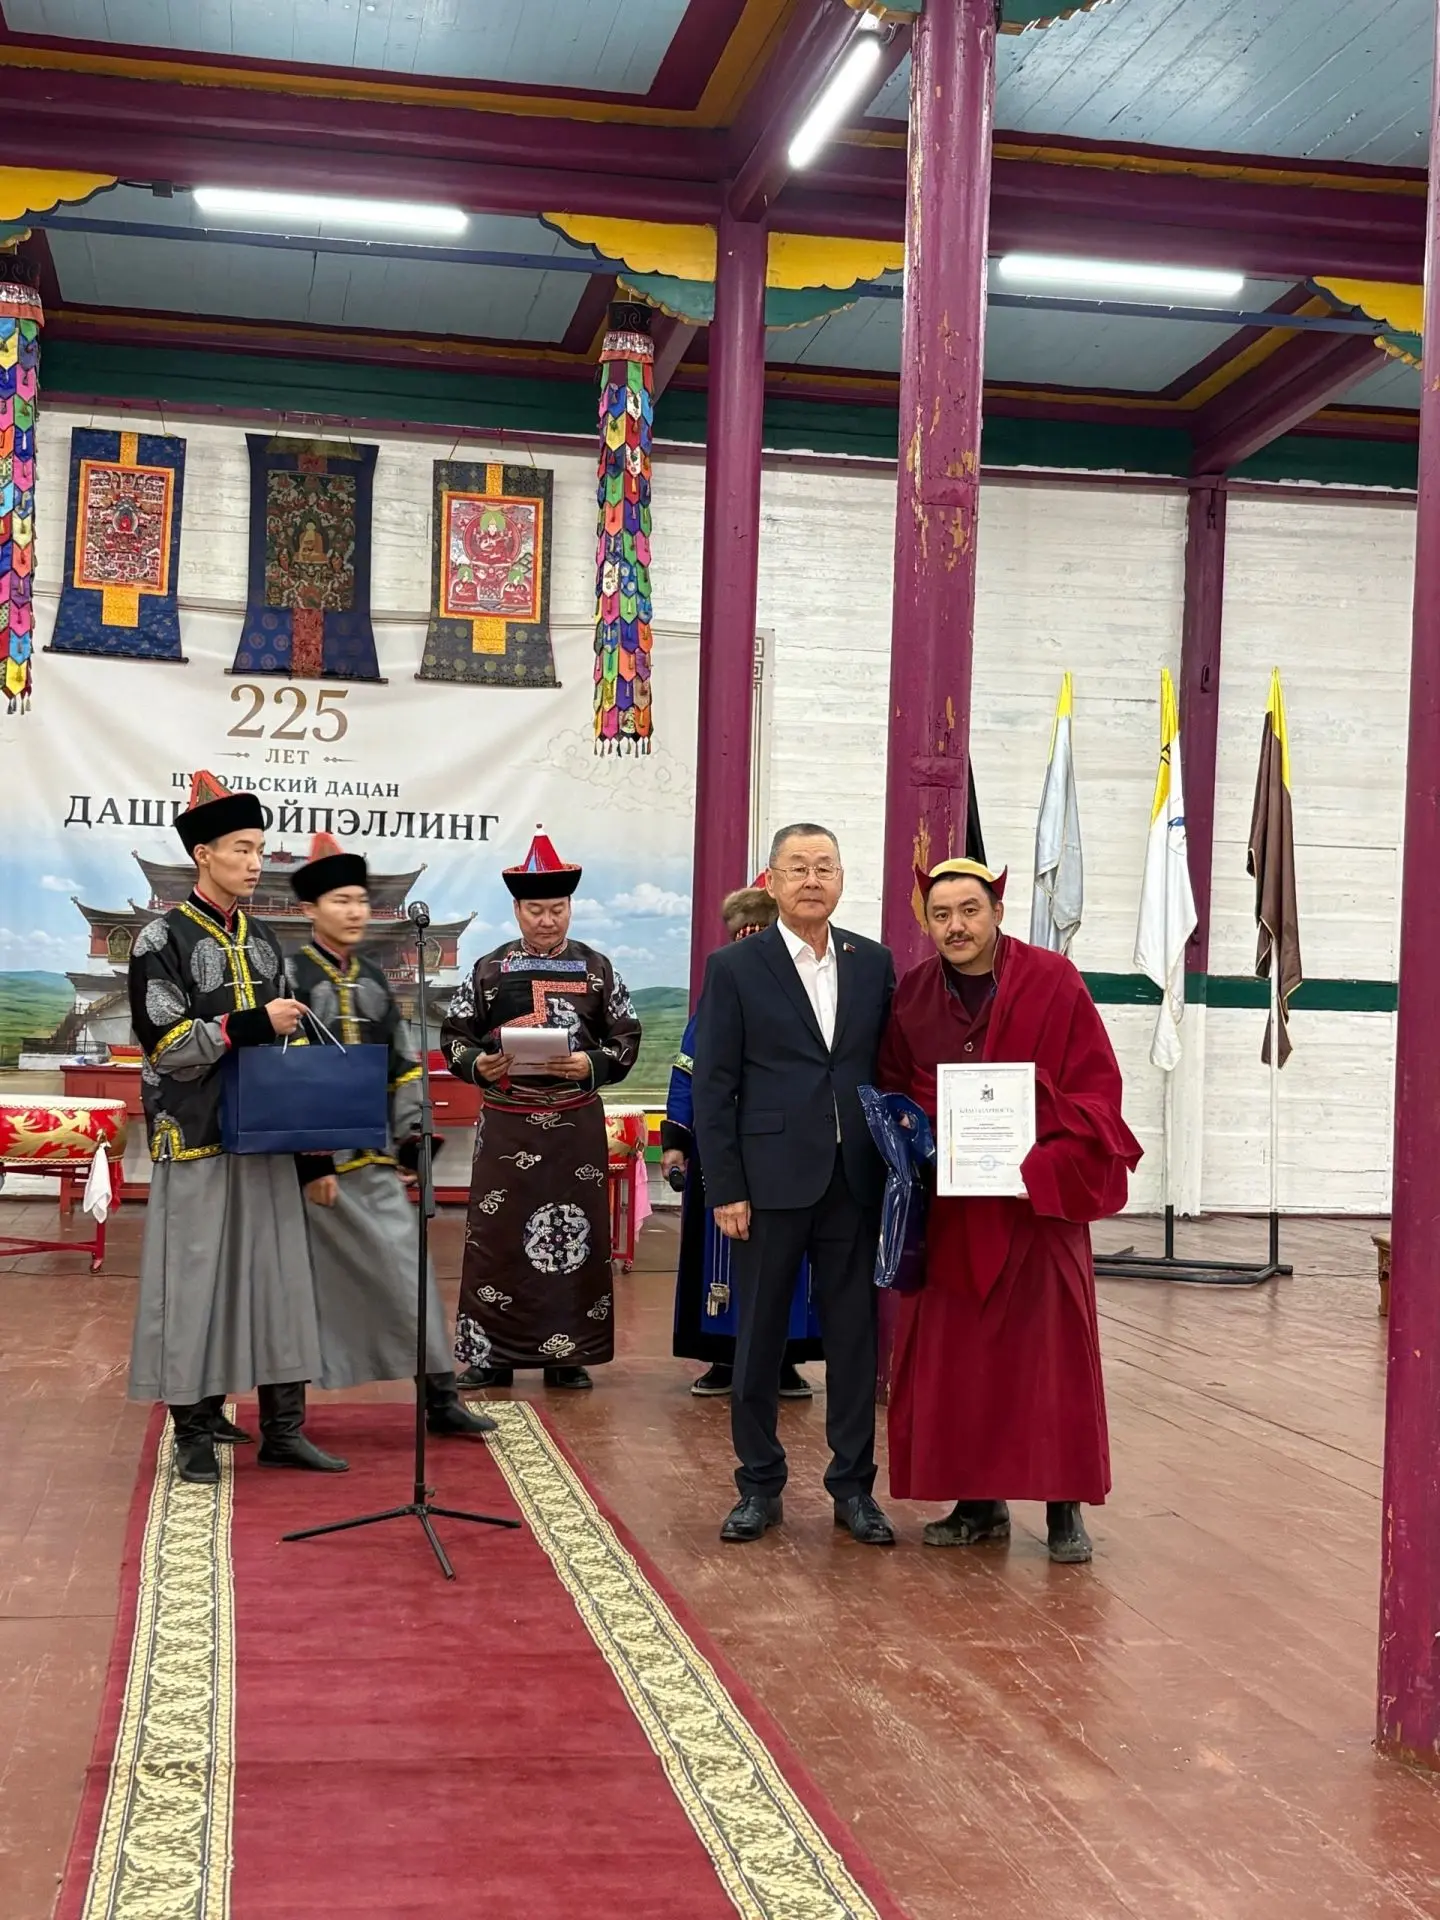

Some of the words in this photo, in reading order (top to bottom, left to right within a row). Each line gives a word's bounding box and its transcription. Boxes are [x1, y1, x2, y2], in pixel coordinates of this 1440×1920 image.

[227, 684, 349, 742] 225
[265, 748, 310, 765] ЛЕТ
[172, 772, 317, 794] ЦУОЛЬСКИЙ
[325, 781, 400, 799] ДАЦАН
